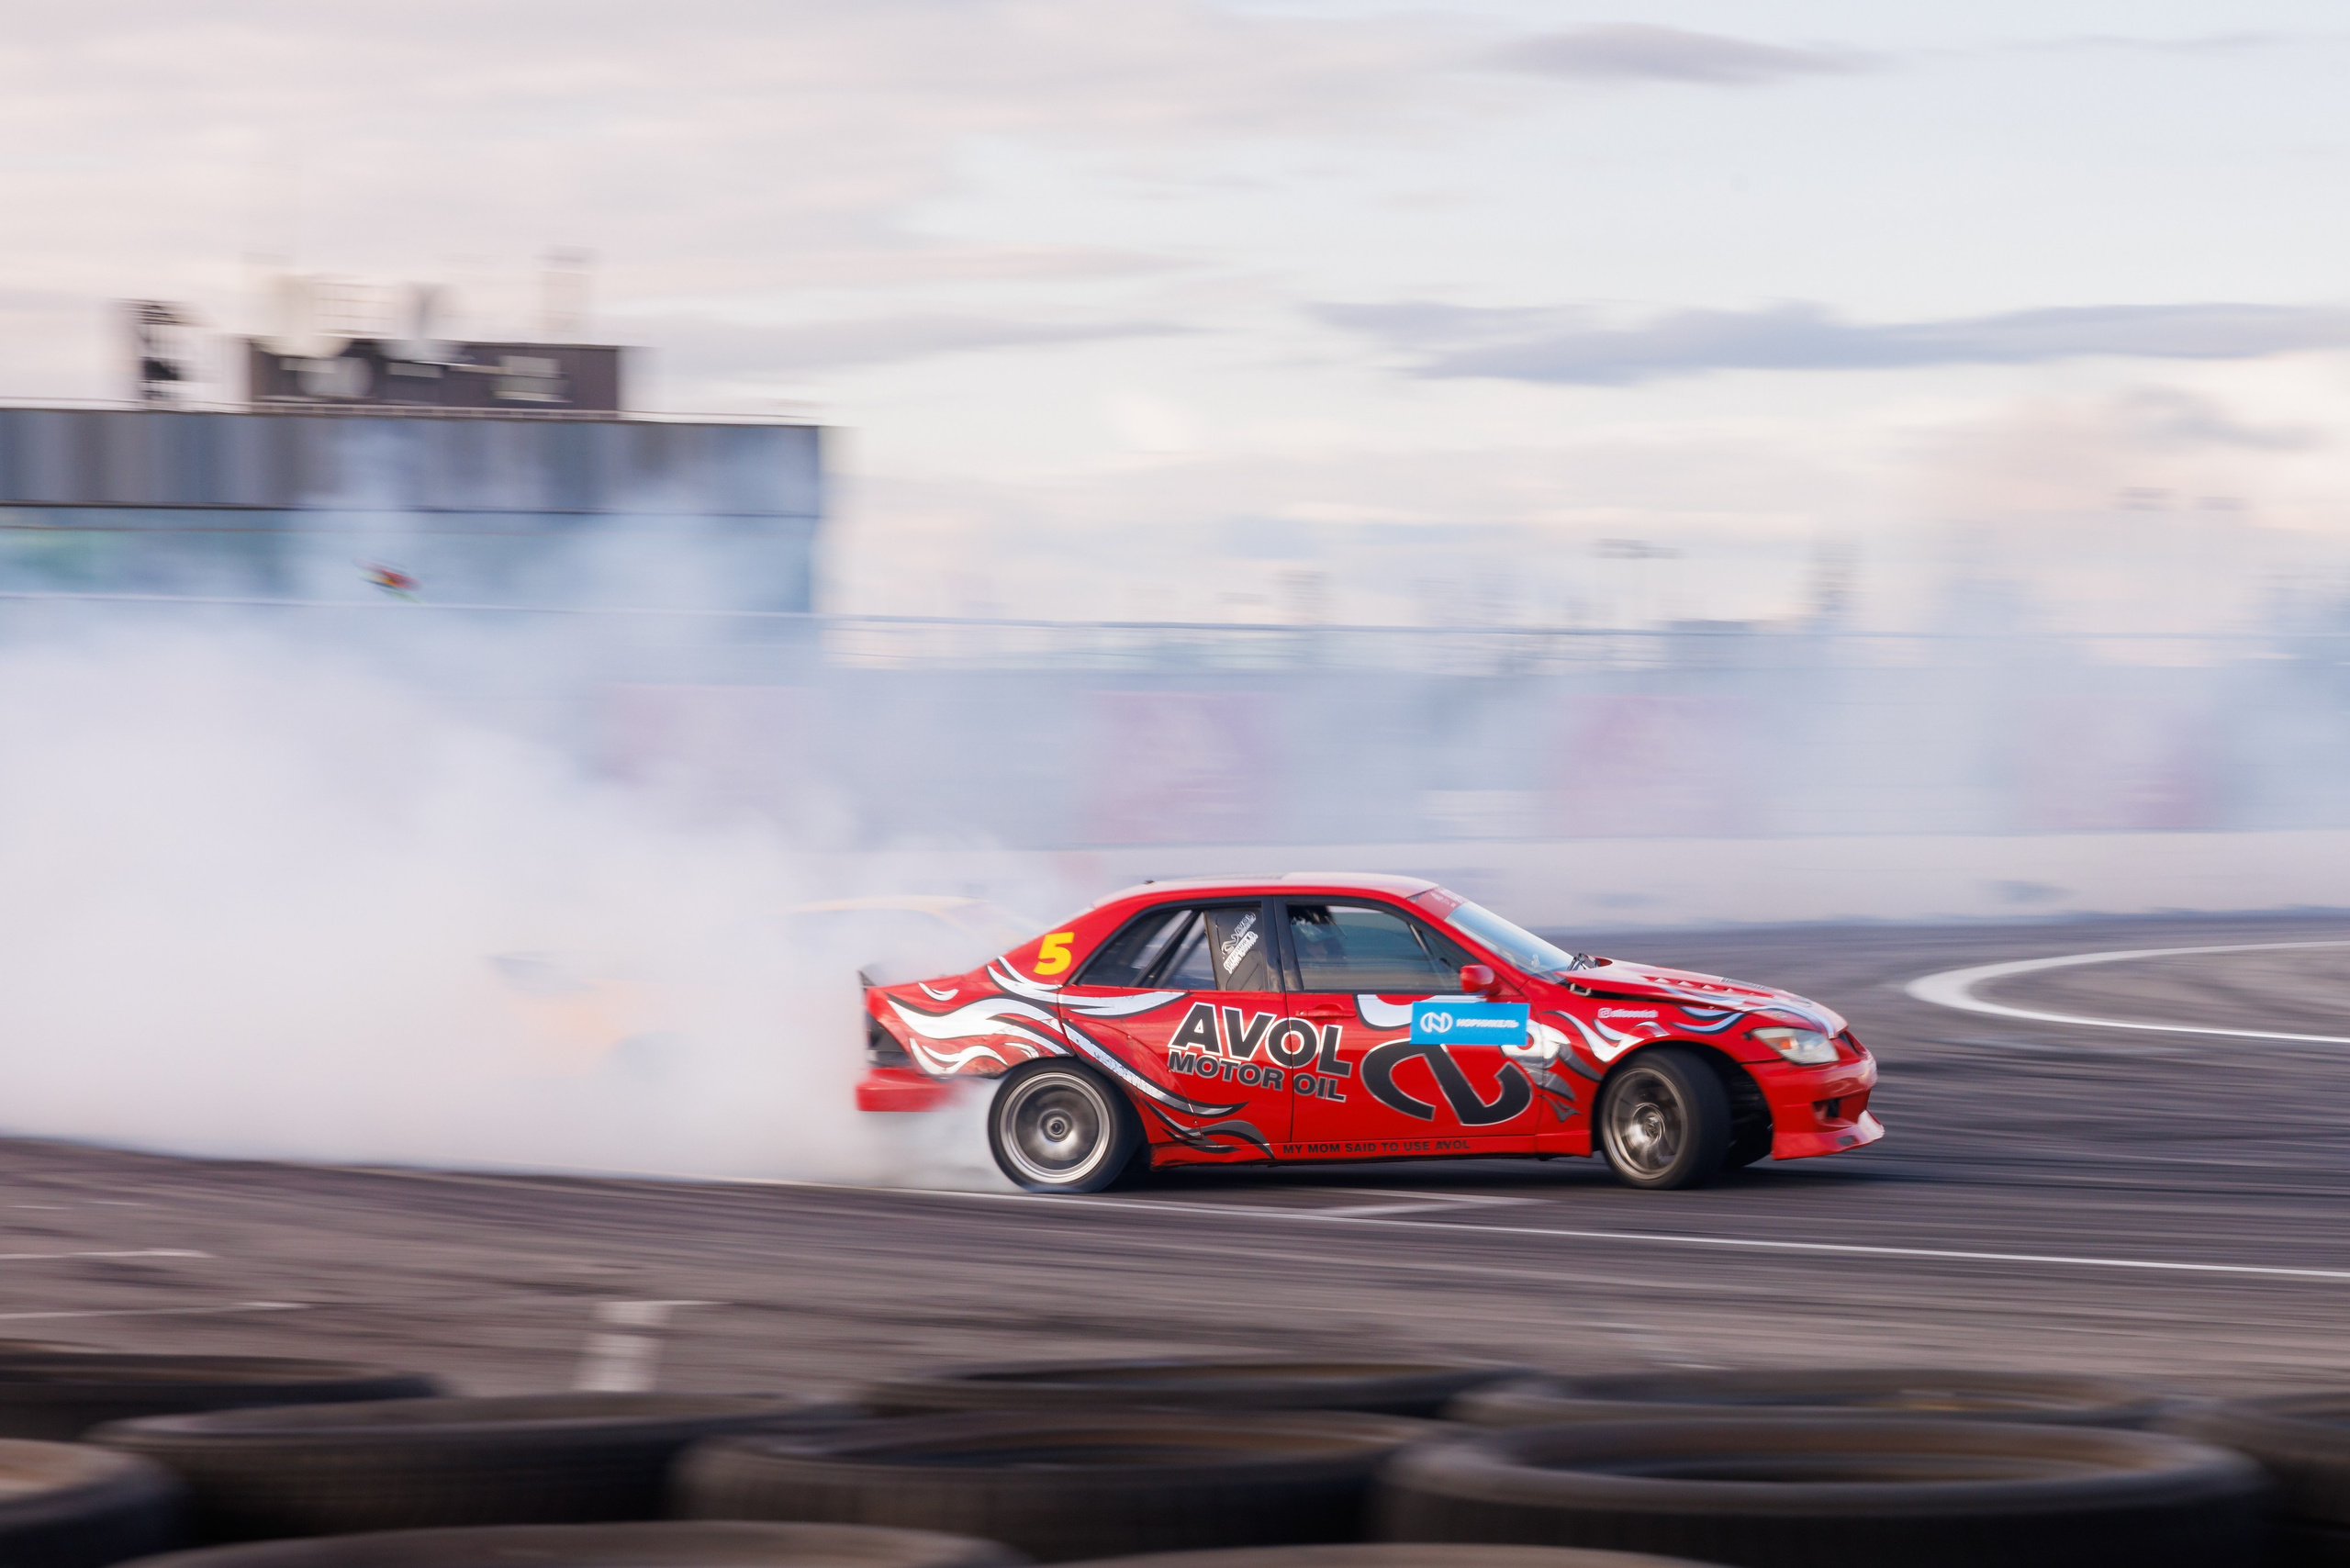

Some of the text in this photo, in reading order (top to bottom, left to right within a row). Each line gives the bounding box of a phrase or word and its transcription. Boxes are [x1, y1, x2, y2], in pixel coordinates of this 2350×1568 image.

[1033, 932, 1075, 975] 5
[1168, 1002, 1353, 1078] AVOL
[1168, 1048, 1348, 1103] MOTOR OIL
[1283, 1139, 1470, 1154] MY MOM SAID TO USE AVOL
